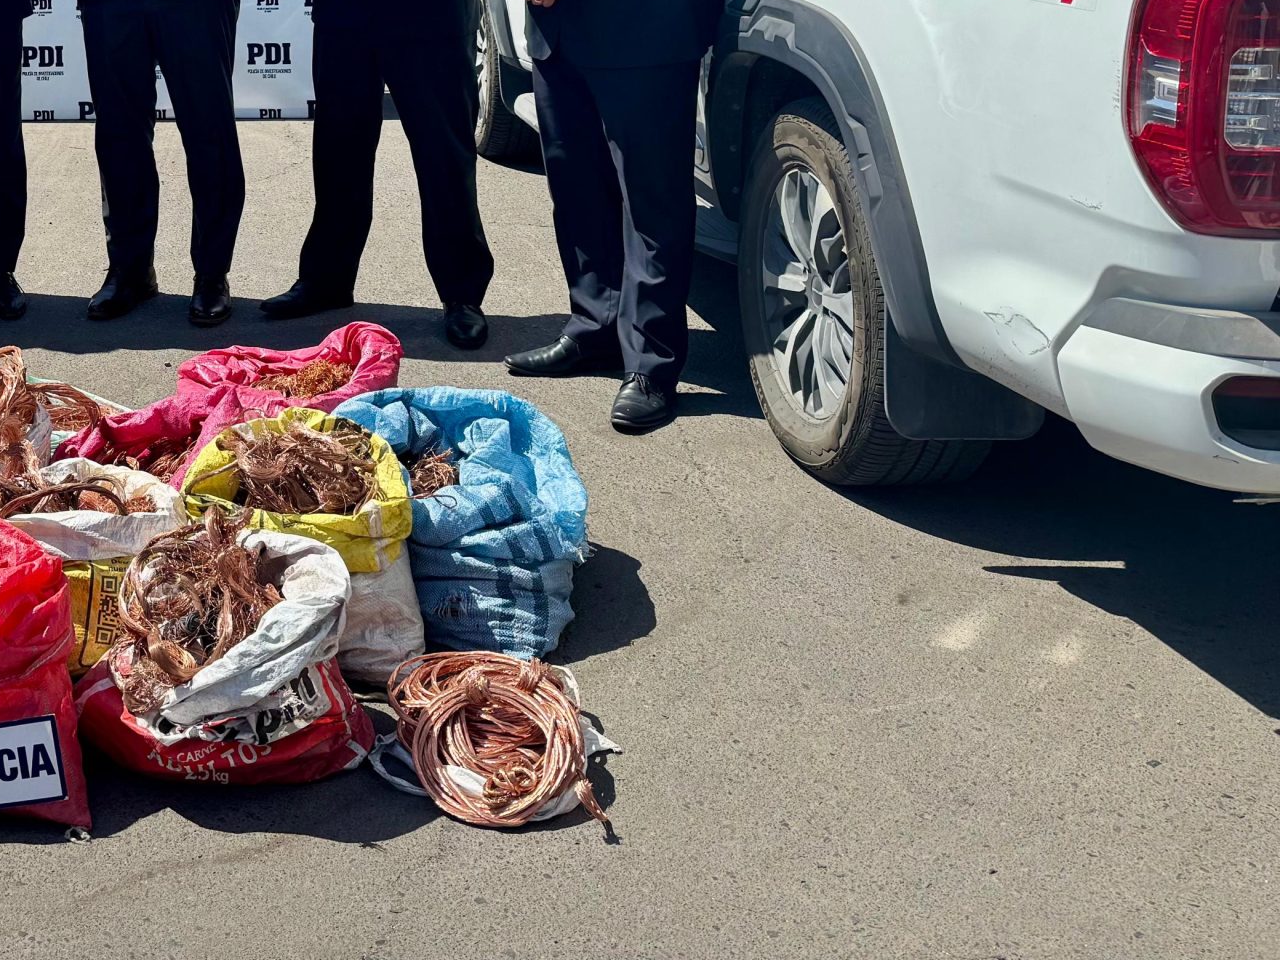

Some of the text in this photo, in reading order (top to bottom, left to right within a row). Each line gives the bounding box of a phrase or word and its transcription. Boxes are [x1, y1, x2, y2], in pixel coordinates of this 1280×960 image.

[31, 0, 52, 10] PDI
[22, 46, 64, 68] PDI
[247, 42, 292, 65] PDI
[33, 110, 54, 121] PDI
[260, 108, 282, 119] PDI
